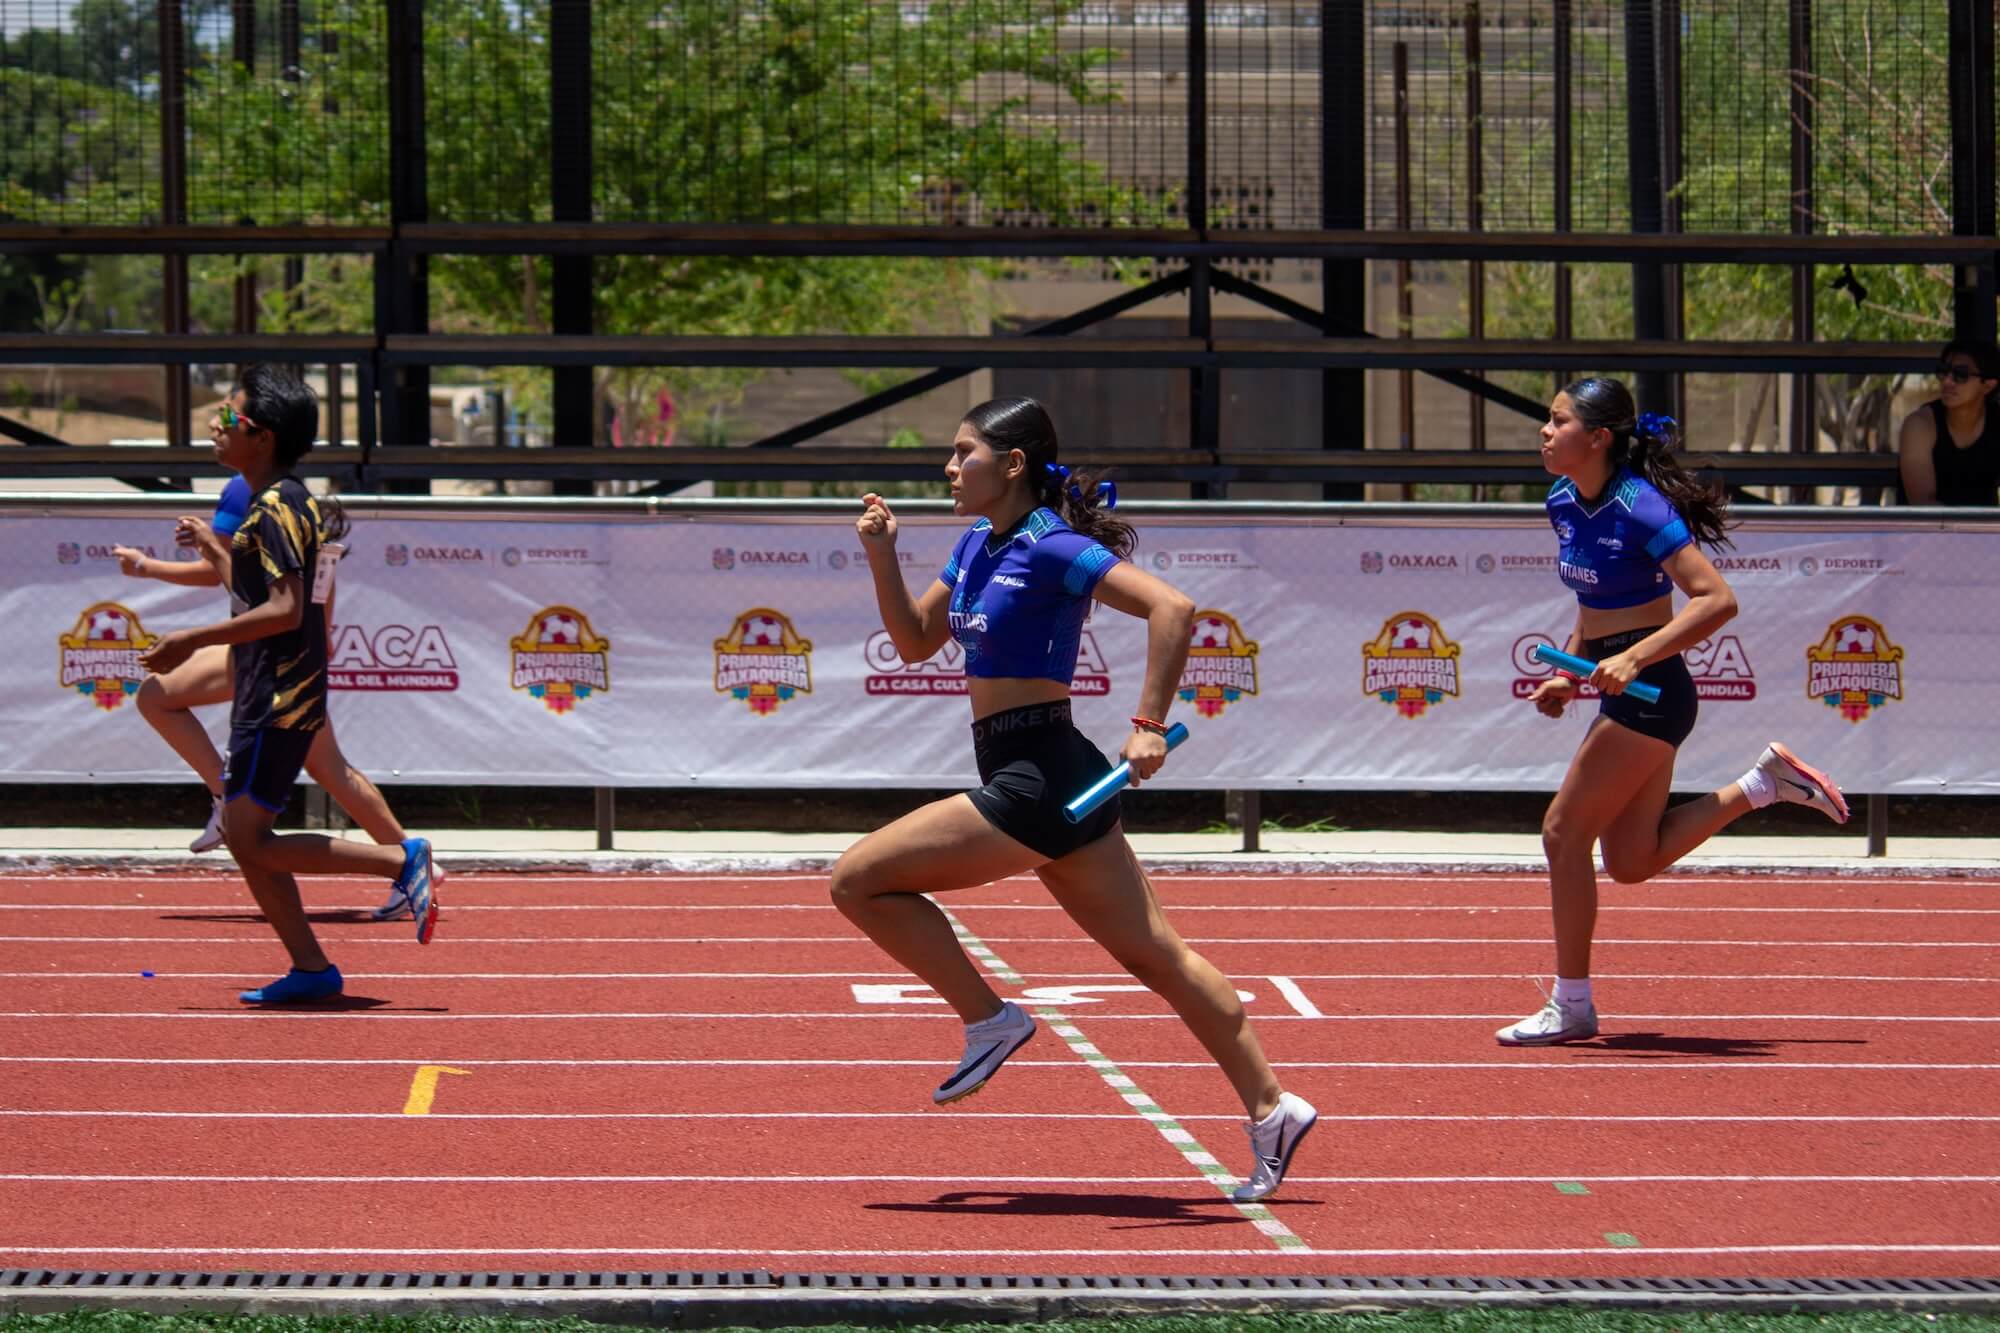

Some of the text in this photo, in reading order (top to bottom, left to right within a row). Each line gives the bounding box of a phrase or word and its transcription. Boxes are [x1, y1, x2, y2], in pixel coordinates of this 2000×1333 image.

[414, 548, 588, 560] OAXACA DEPORTE
[740, 551, 808, 564] OAXACA
[1178, 553, 1238, 562] DEPORTE
[1389, 555, 1458, 567] OAXACA
[1712, 558, 1883, 570] OAXACA DEPORTE
[516, 653, 605, 670] PRIMAVERA
[720, 655, 807, 672] PRIMAVERA
[1368, 658, 1456, 675] PRIMAVERA
[1812, 662, 1898, 679] PRIMAVERA
[356, 675, 383, 687] DEL
[386, 675, 454, 687] MUNDIAL
[869, 680, 890, 691] LA
[891, 680, 930, 691] CASA
[1696, 684, 1750, 696] UNDIAL
[991, 708, 1043, 737] NIKE
